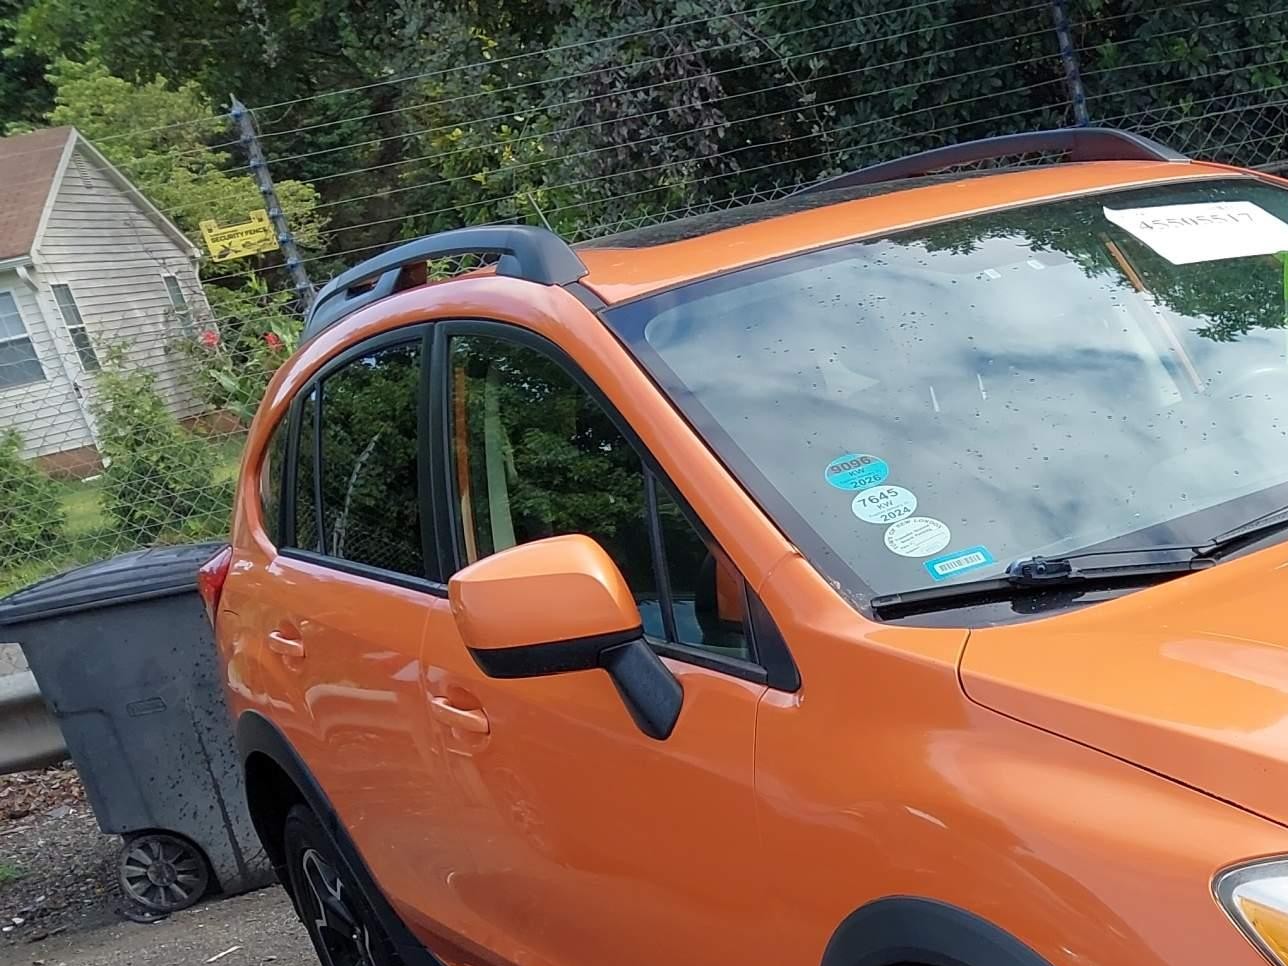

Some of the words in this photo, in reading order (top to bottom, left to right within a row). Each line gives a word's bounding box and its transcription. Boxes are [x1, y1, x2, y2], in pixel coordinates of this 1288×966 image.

[1139, 212, 1254, 231] 45505517
[211, 231, 244, 243] SECURITY
[244, 226, 267, 235] FENCE
[830, 455, 872, 474] 9096
[848, 467, 865, 477] KW
[850, 474, 882, 489] 2026
[857, 488, 899, 508] 7645
[876, 499, 894, 510] KW
[880, 506, 912, 522] 2024
